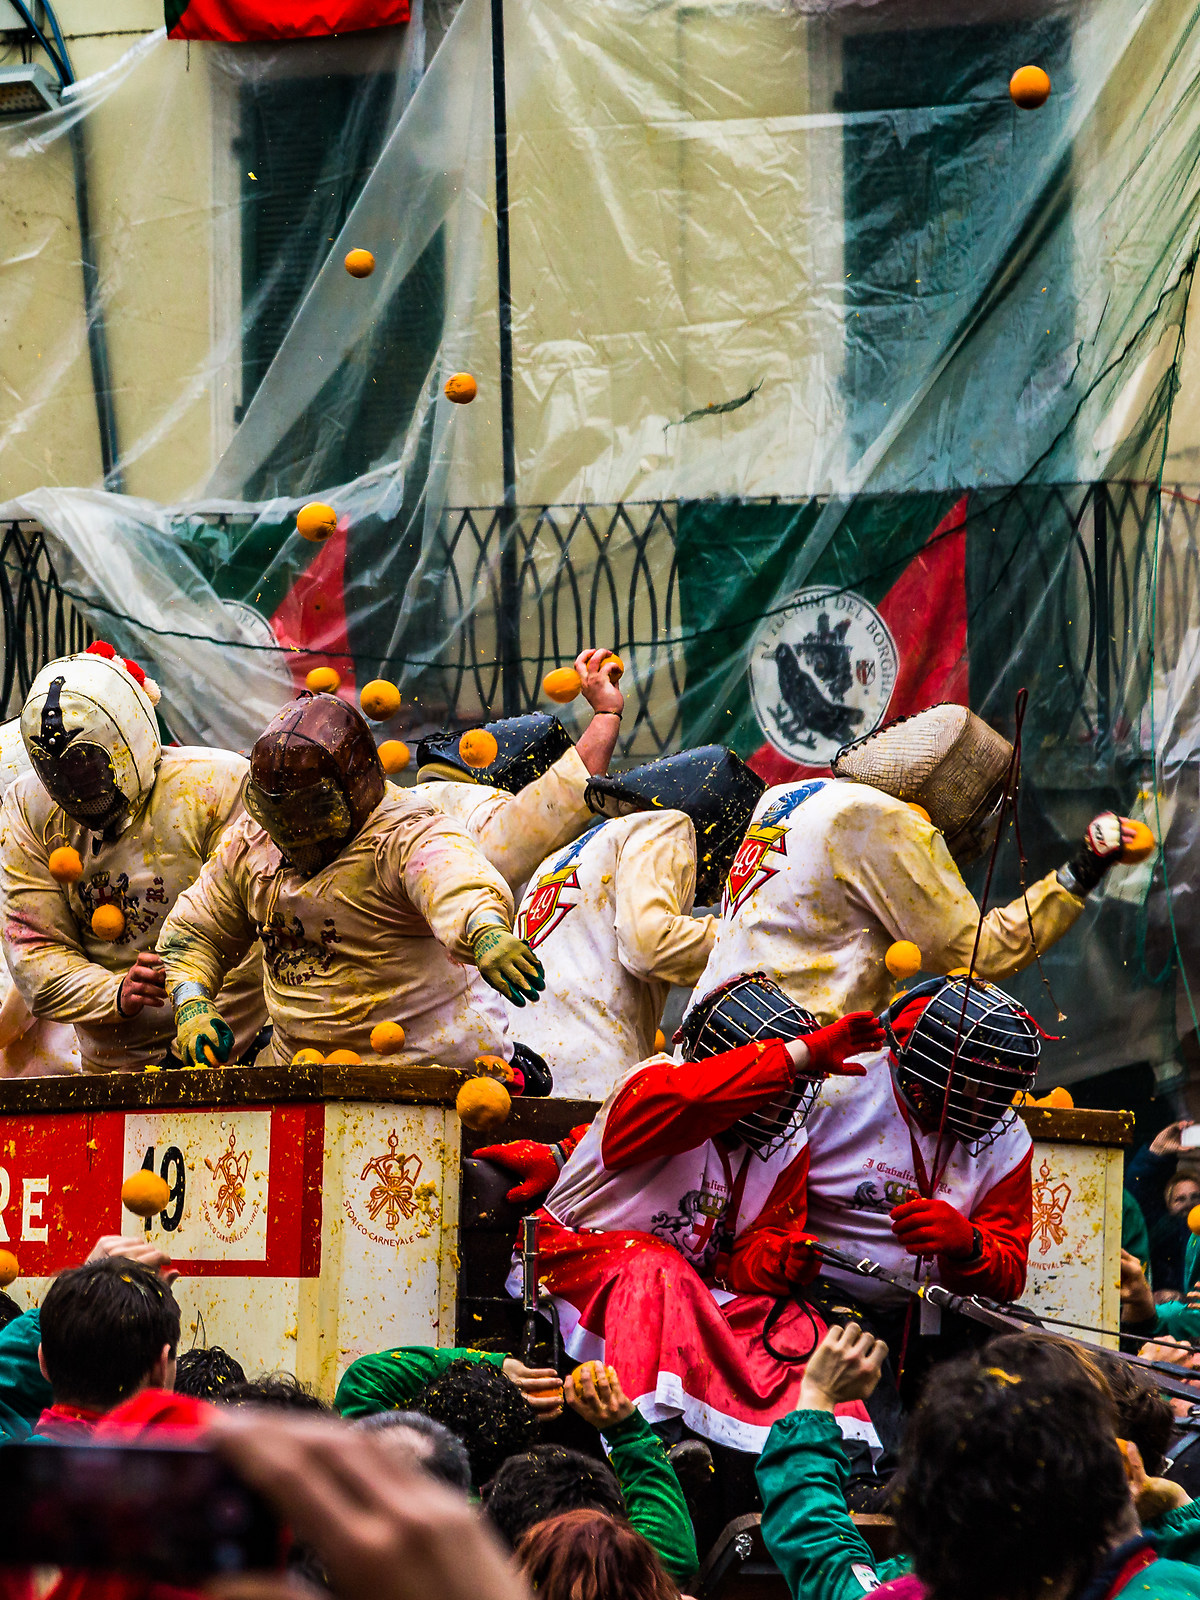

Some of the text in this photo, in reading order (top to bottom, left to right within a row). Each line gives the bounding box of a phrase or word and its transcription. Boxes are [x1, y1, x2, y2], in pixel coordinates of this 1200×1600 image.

[734, 843, 761, 877] 49
[530, 886, 555, 920] 49
[343, 1200, 368, 1236] STORICO
[369, 1232, 415, 1247] CARNEVALE
[1028, 1259, 1064, 1272] ARNEVALE
